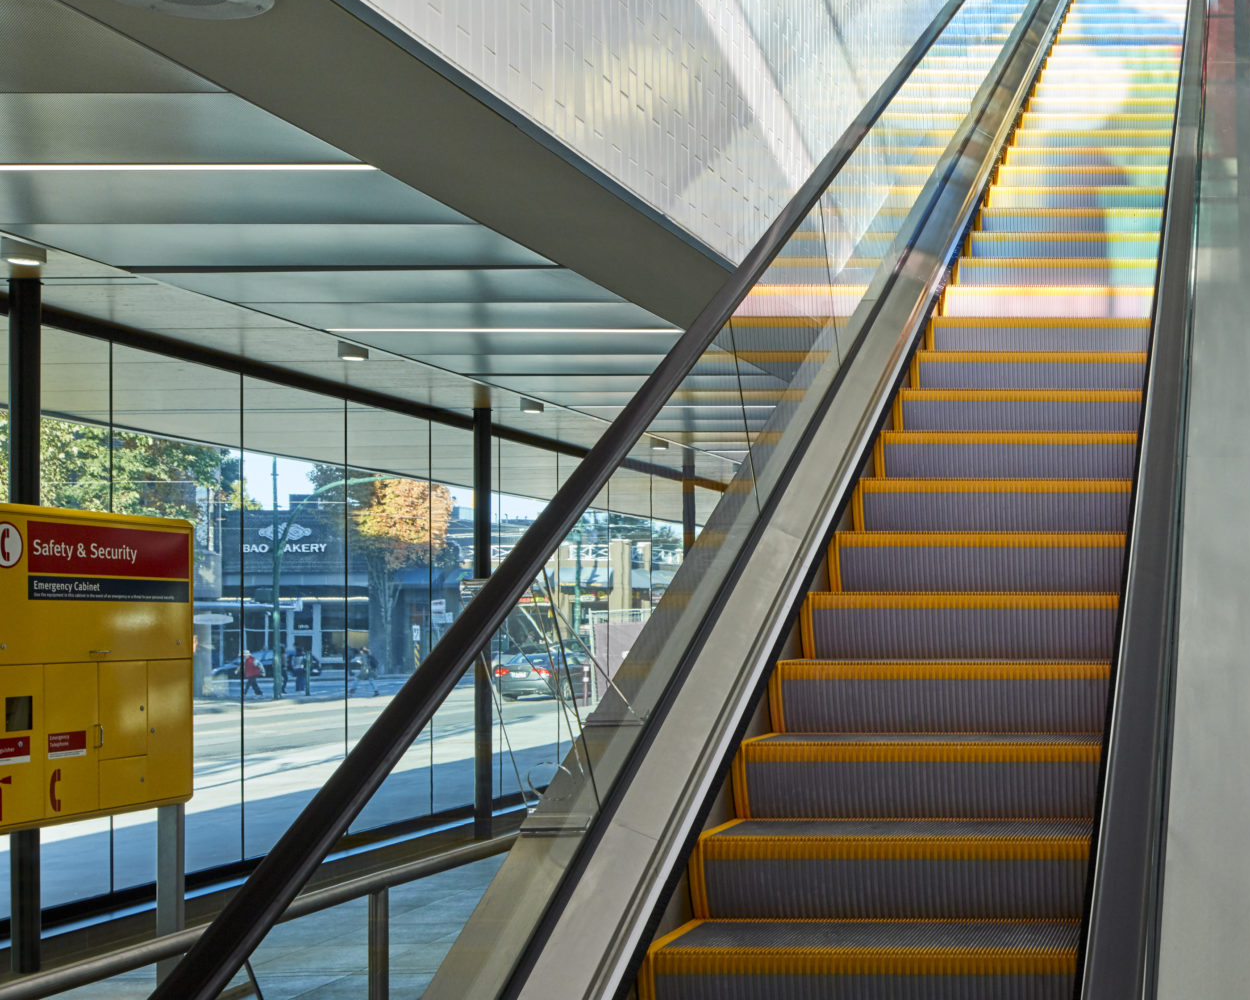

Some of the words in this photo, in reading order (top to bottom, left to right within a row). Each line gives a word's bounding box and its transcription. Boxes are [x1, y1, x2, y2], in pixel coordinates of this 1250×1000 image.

[33, 539, 74, 561] Safety
[77, 543, 86, 558] &
[90, 543, 137, 564] Security
[243, 543, 270, 553] BAO
[283, 543, 327, 553] AKERY
[33, 580, 73, 593] Emergency
[74, 581, 100, 592] Cabinet
